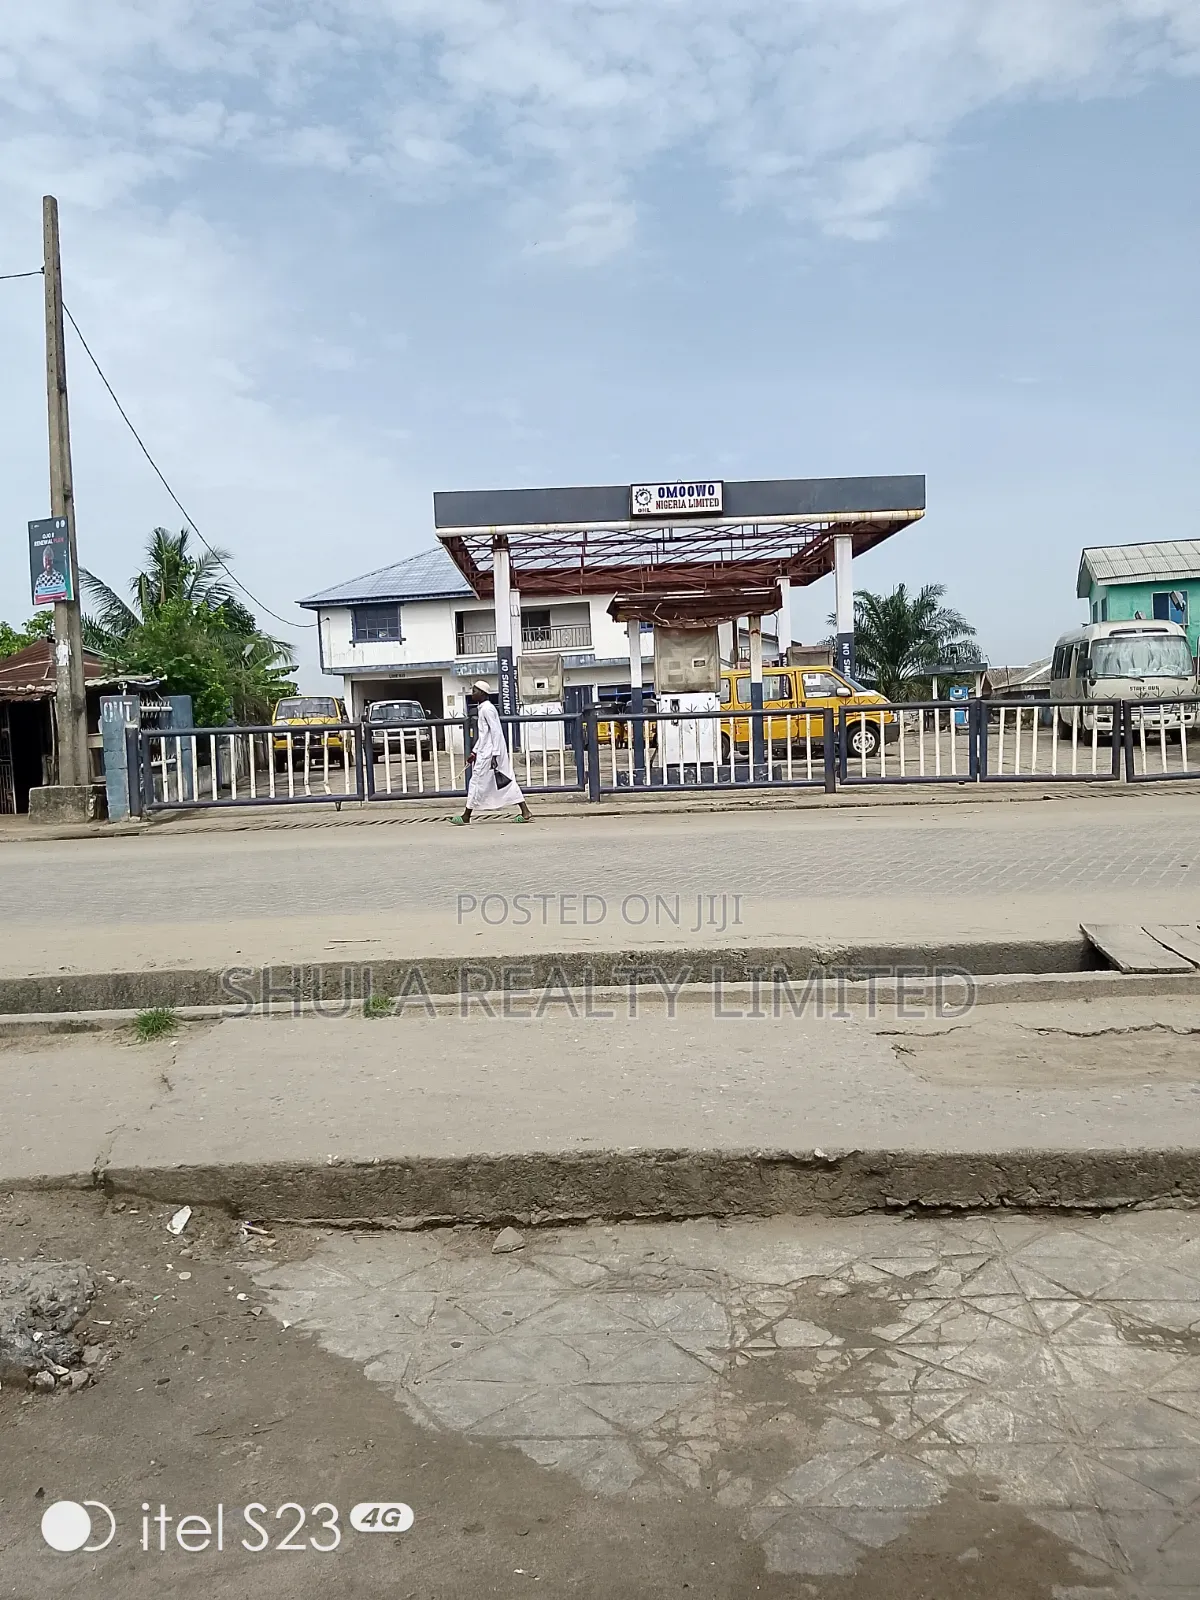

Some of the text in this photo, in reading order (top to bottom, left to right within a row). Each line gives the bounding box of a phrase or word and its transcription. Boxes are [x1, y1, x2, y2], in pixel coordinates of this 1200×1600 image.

[658, 484, 715, 499] OMOOWO
[655, 497, 720, 510] NIGERIA LIMITED
[842, 642, 850, 656] NO
[501, 659, 511, 715] NO SMOKING
